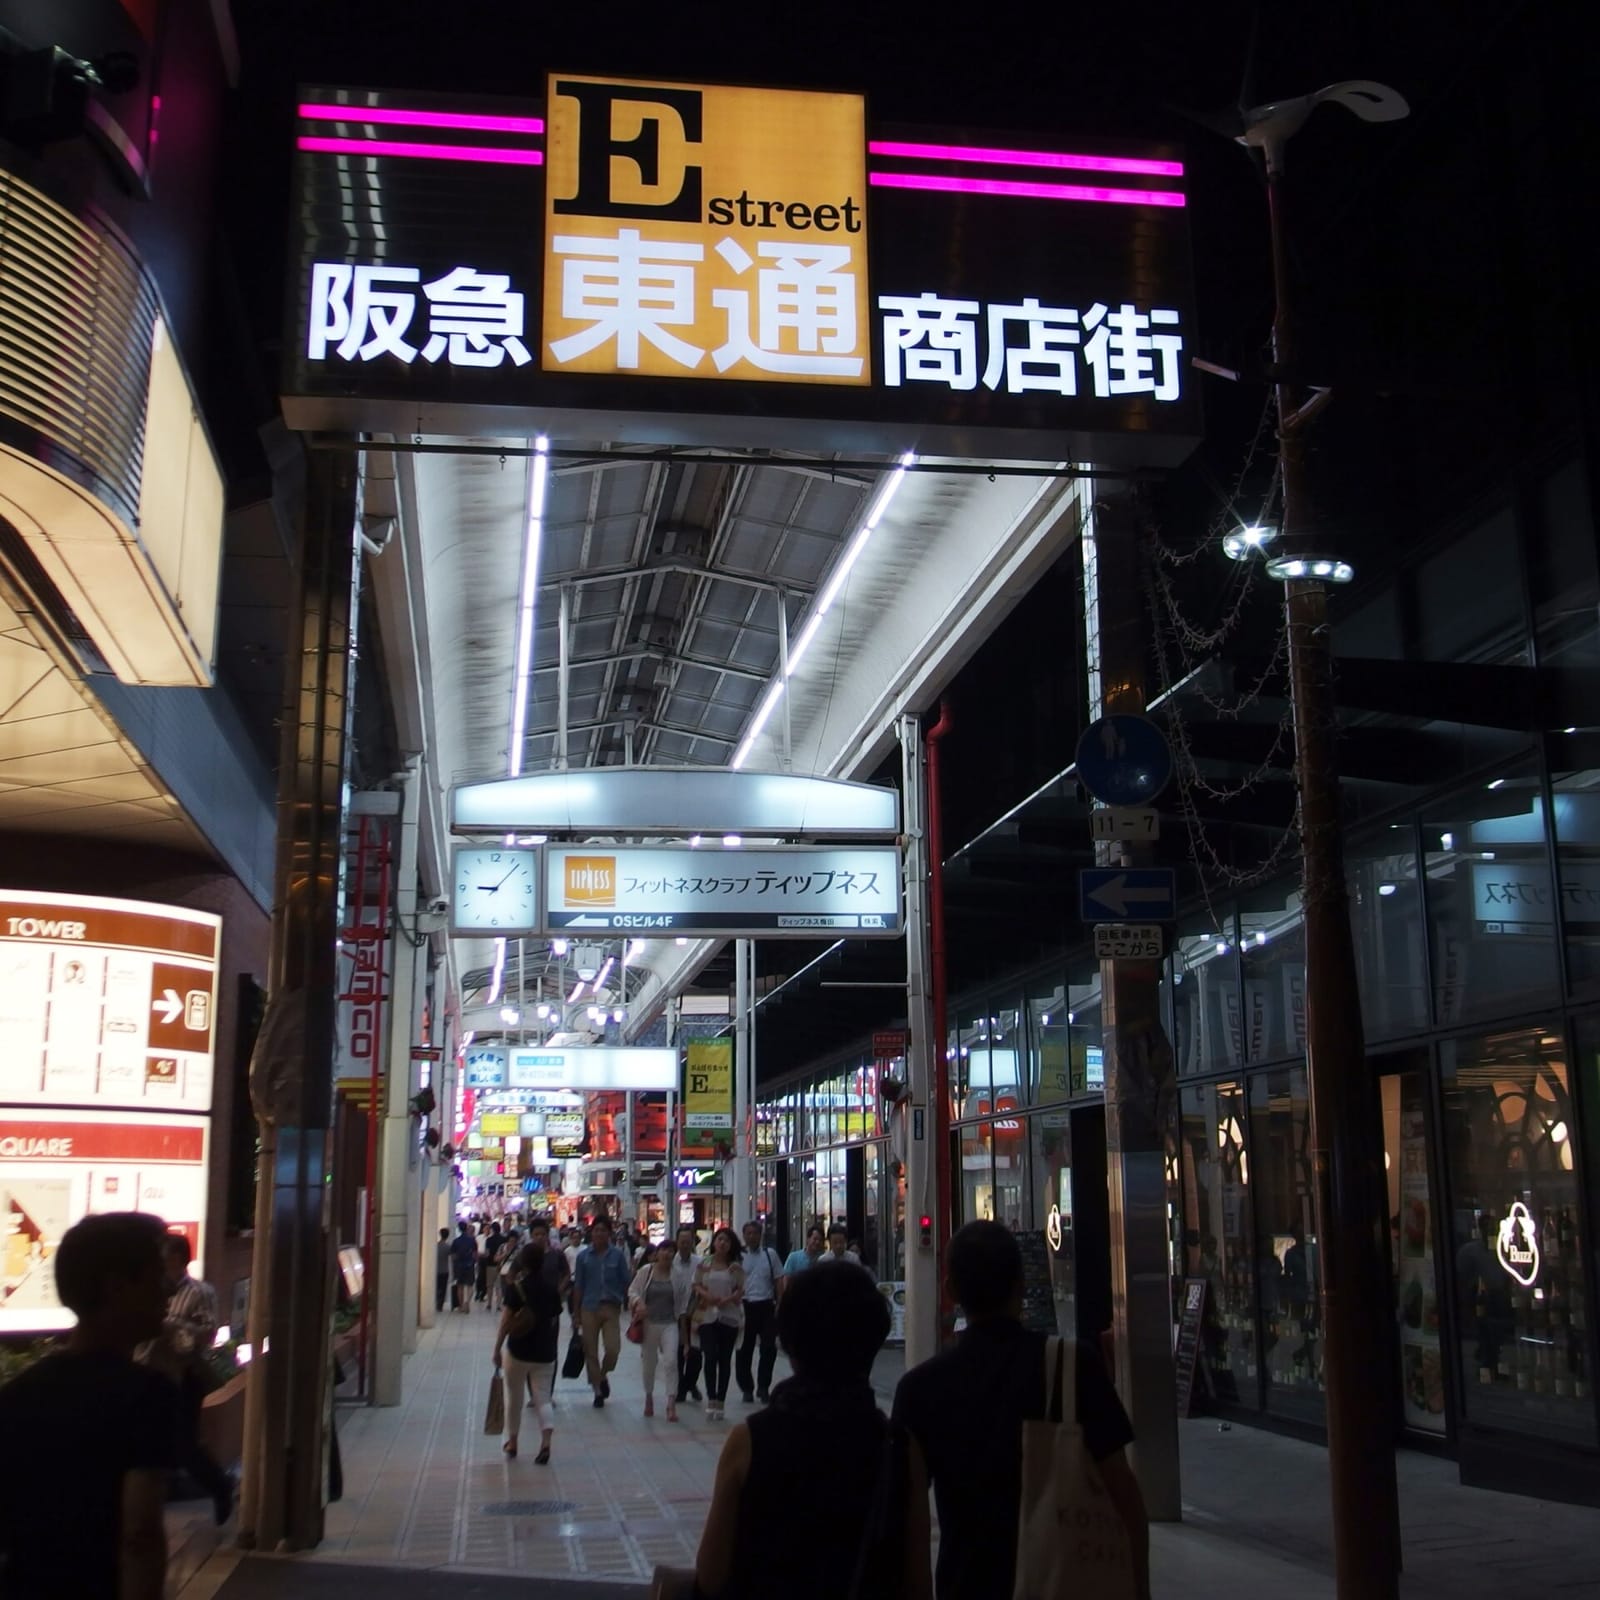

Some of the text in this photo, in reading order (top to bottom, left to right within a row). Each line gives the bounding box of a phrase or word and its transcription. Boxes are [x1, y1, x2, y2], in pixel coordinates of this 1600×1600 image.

[553, 81, 862, 233] E street
[307, 229, 1183, 402] 阪急 東通 商店街
[623, 870, 881, 896] フィットネスクラブ ティップネス
[7, 917, 87, 940] TOWER
[612, 914, 674, 928] OSビル4F
[1098, 941, 1161, 957] ここから
[691, 1074, 709, 1094] E
[0, 1136, 74, 1157] QUARE
